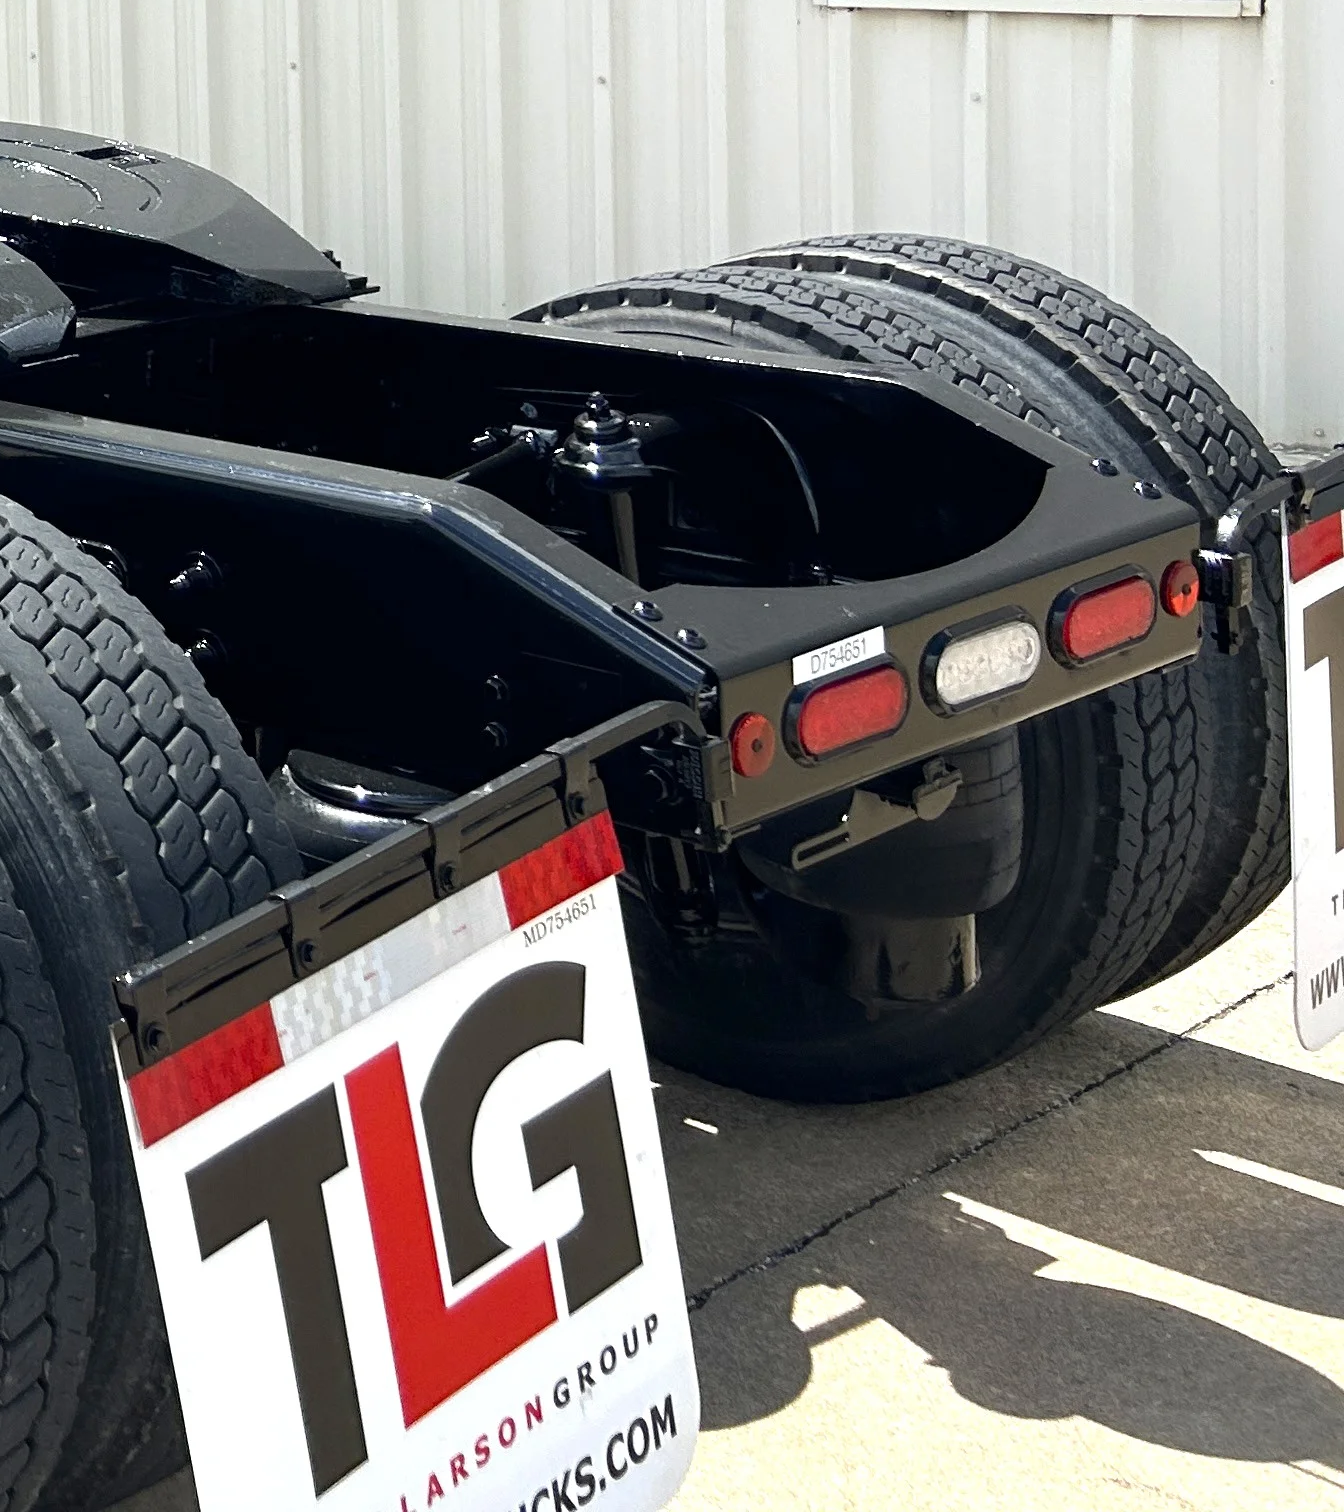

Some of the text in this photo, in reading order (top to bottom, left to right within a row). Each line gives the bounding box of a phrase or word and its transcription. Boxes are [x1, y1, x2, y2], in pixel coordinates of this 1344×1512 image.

[810, 637, 866, 674] D754651
[522, 893, 596, 948] MD754651
[185, 961, 643, 1500] TLG
